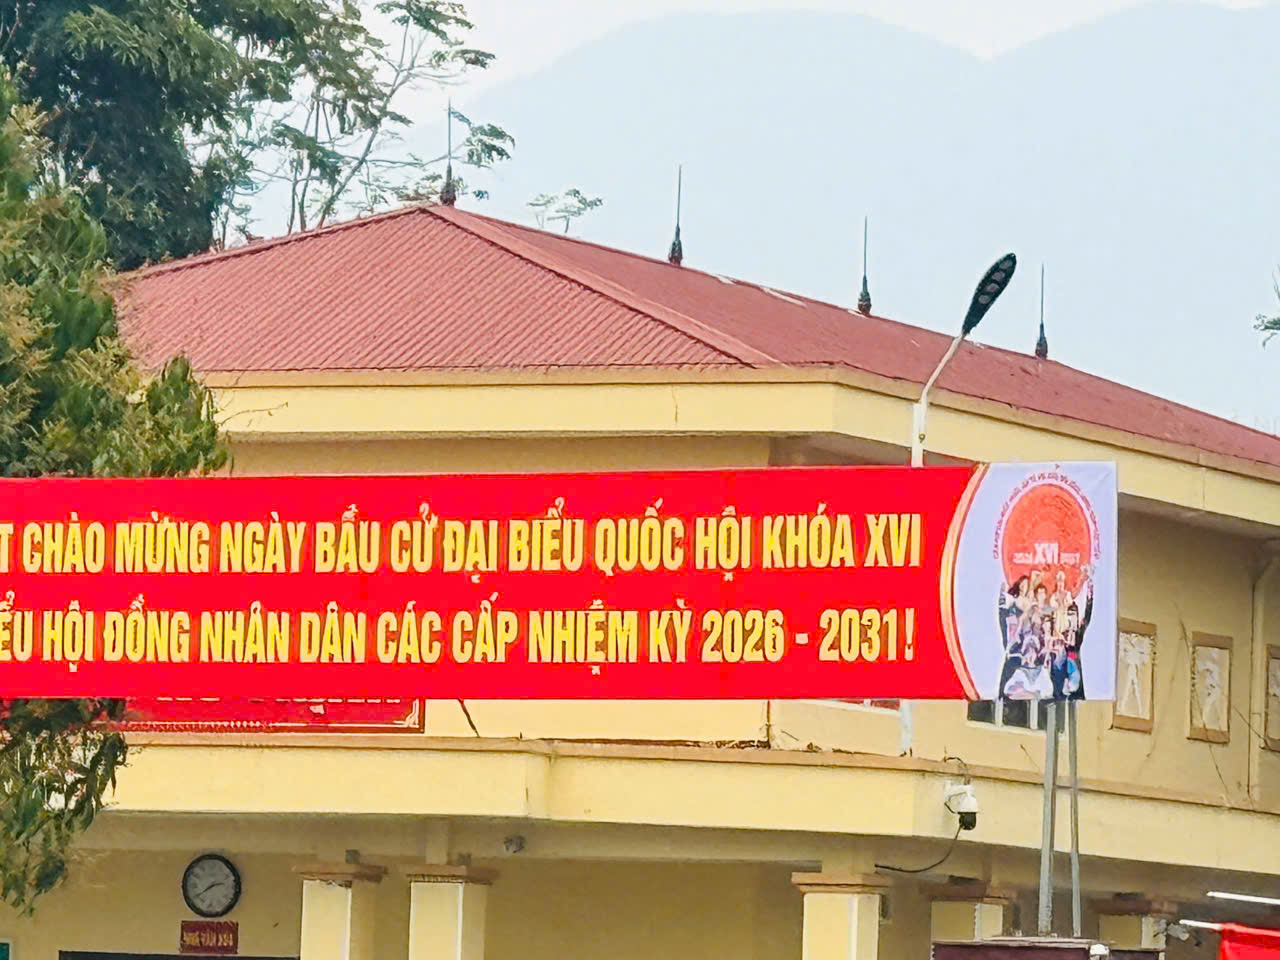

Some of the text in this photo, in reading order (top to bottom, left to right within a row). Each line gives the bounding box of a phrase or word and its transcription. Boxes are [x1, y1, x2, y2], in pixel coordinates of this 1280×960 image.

[22, 511, 106, 574] CHÀO
[115, 511, 210, 574] MỪNG
[219, 511, 307, 573] NGÀY
[314, 503, 381, 573] BẦU
[390, 502, 439, 573] CỬ
[442, 519, 499, 584] ĐẠI
[508, 497, 585, 572] BIỂU
[594, 497, 685, 577] QUỐC
[695, 505, 752, 582] HỘI
[762, 503, 856, 569] KHÓA
[863, 513, 921, 567] XVI
[42, 599, 95, 673] HỘI
[102, 593, 191, 663] ĐỒNG
[199, 600, 290, 664] NHÂN
[299, 600, 367, 664] DÂN
[376, 600, 442, 664] CÁC
[451, 591, 519, 664] CẤP
[527, 599, 639, 675] NHIỆM
[649, 598, 693, 663] KỲ
[701, 608, 785, 663] 2026
[795, 632, 809, 645] -
[818, 607, 915, 662] 2031!
